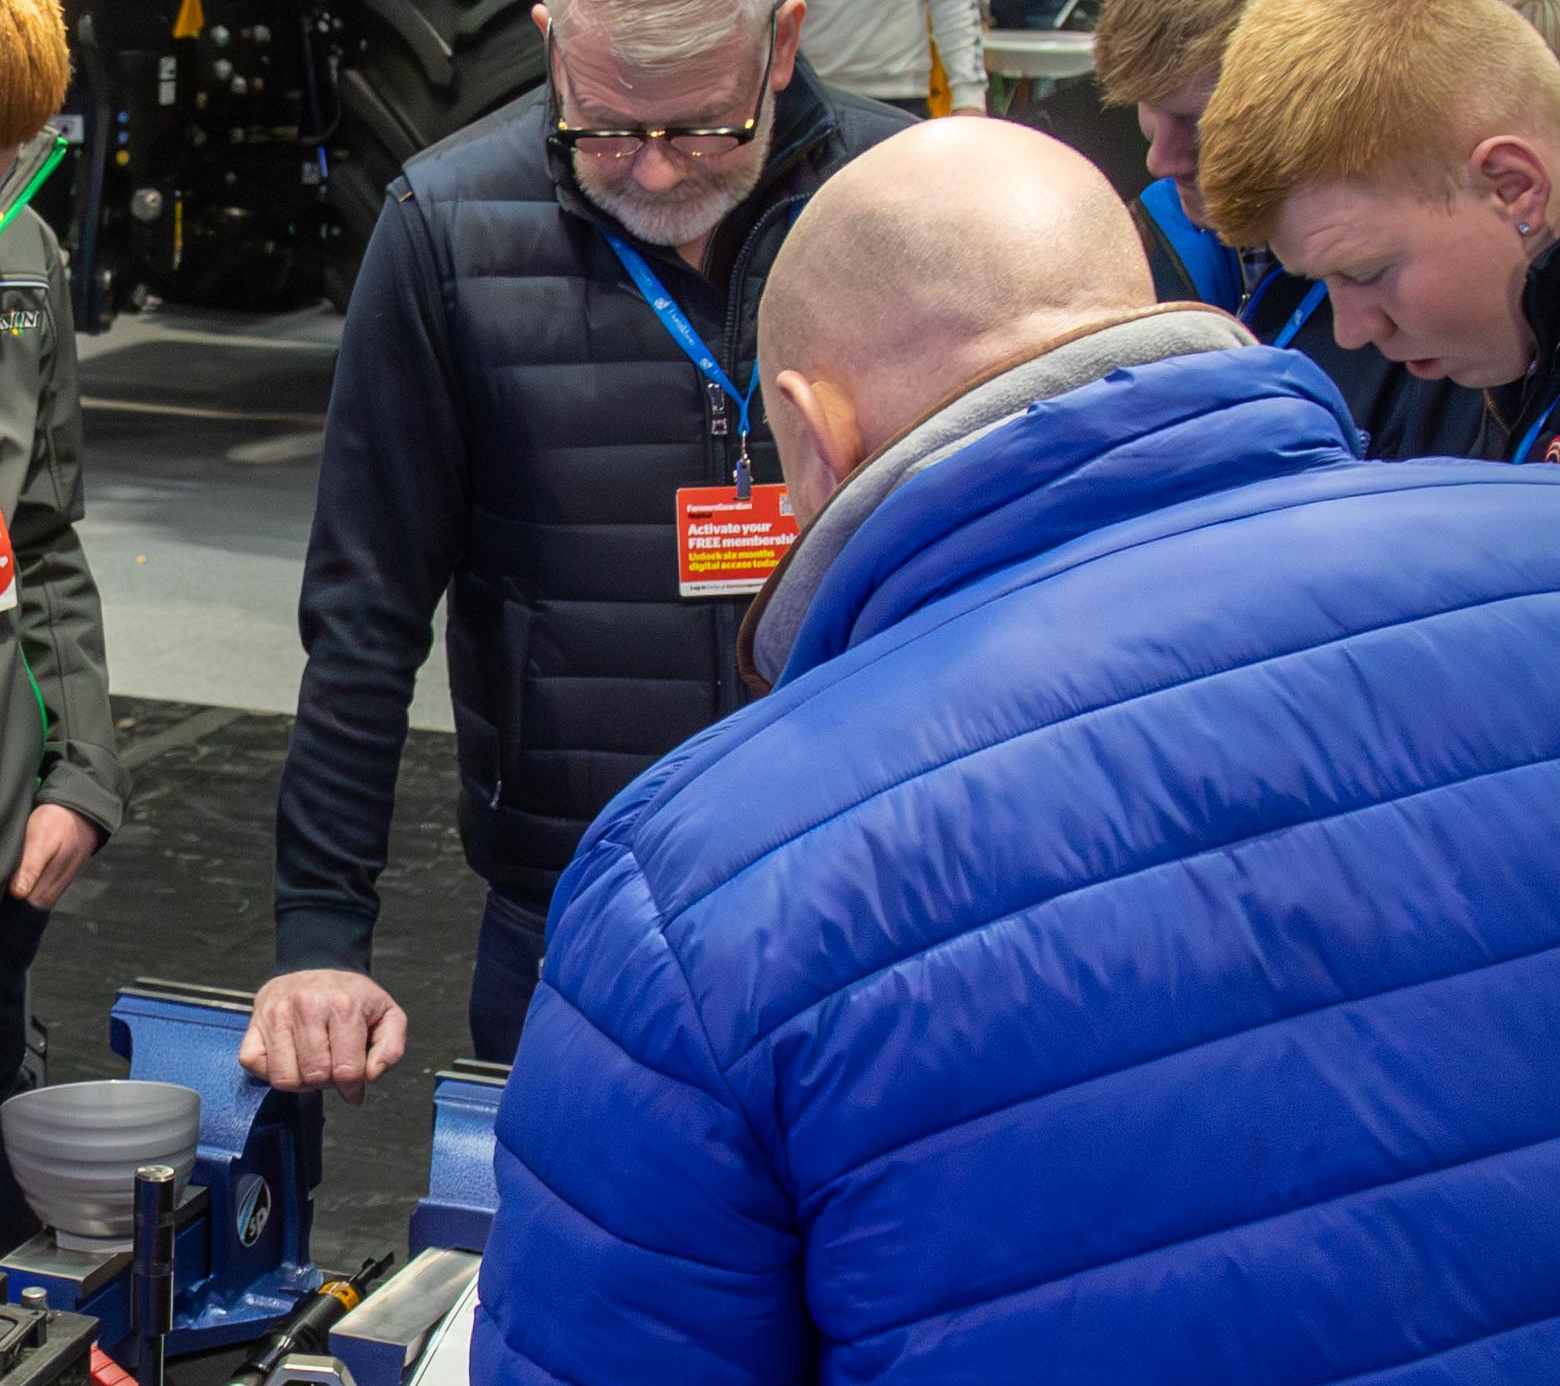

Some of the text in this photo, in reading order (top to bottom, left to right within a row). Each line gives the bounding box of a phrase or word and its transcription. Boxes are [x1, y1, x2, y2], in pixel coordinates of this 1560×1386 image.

[688, 522, 773, 536] Activate your
[688, 537, 721, 549] FREE
[738, 548, 776, 559] months
